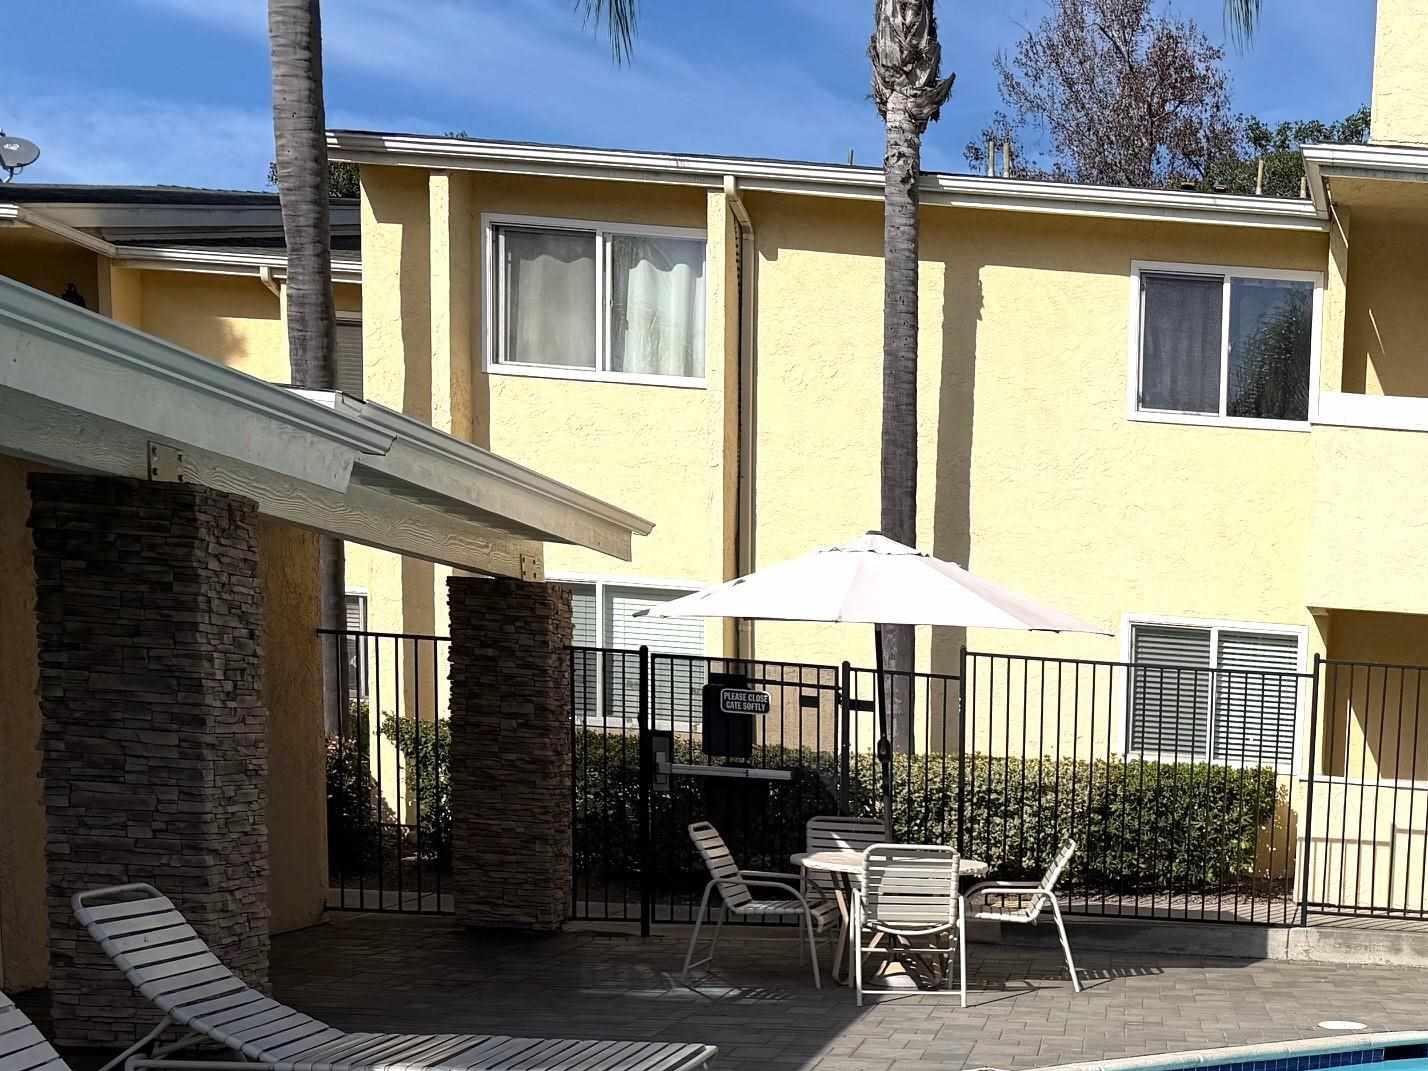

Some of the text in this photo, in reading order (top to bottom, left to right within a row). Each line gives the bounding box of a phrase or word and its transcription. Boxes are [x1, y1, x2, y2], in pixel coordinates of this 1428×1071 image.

[723, 691, 768, 703] PLEASE CLOSE
[742, 702, 766, 712] SOFTLY
